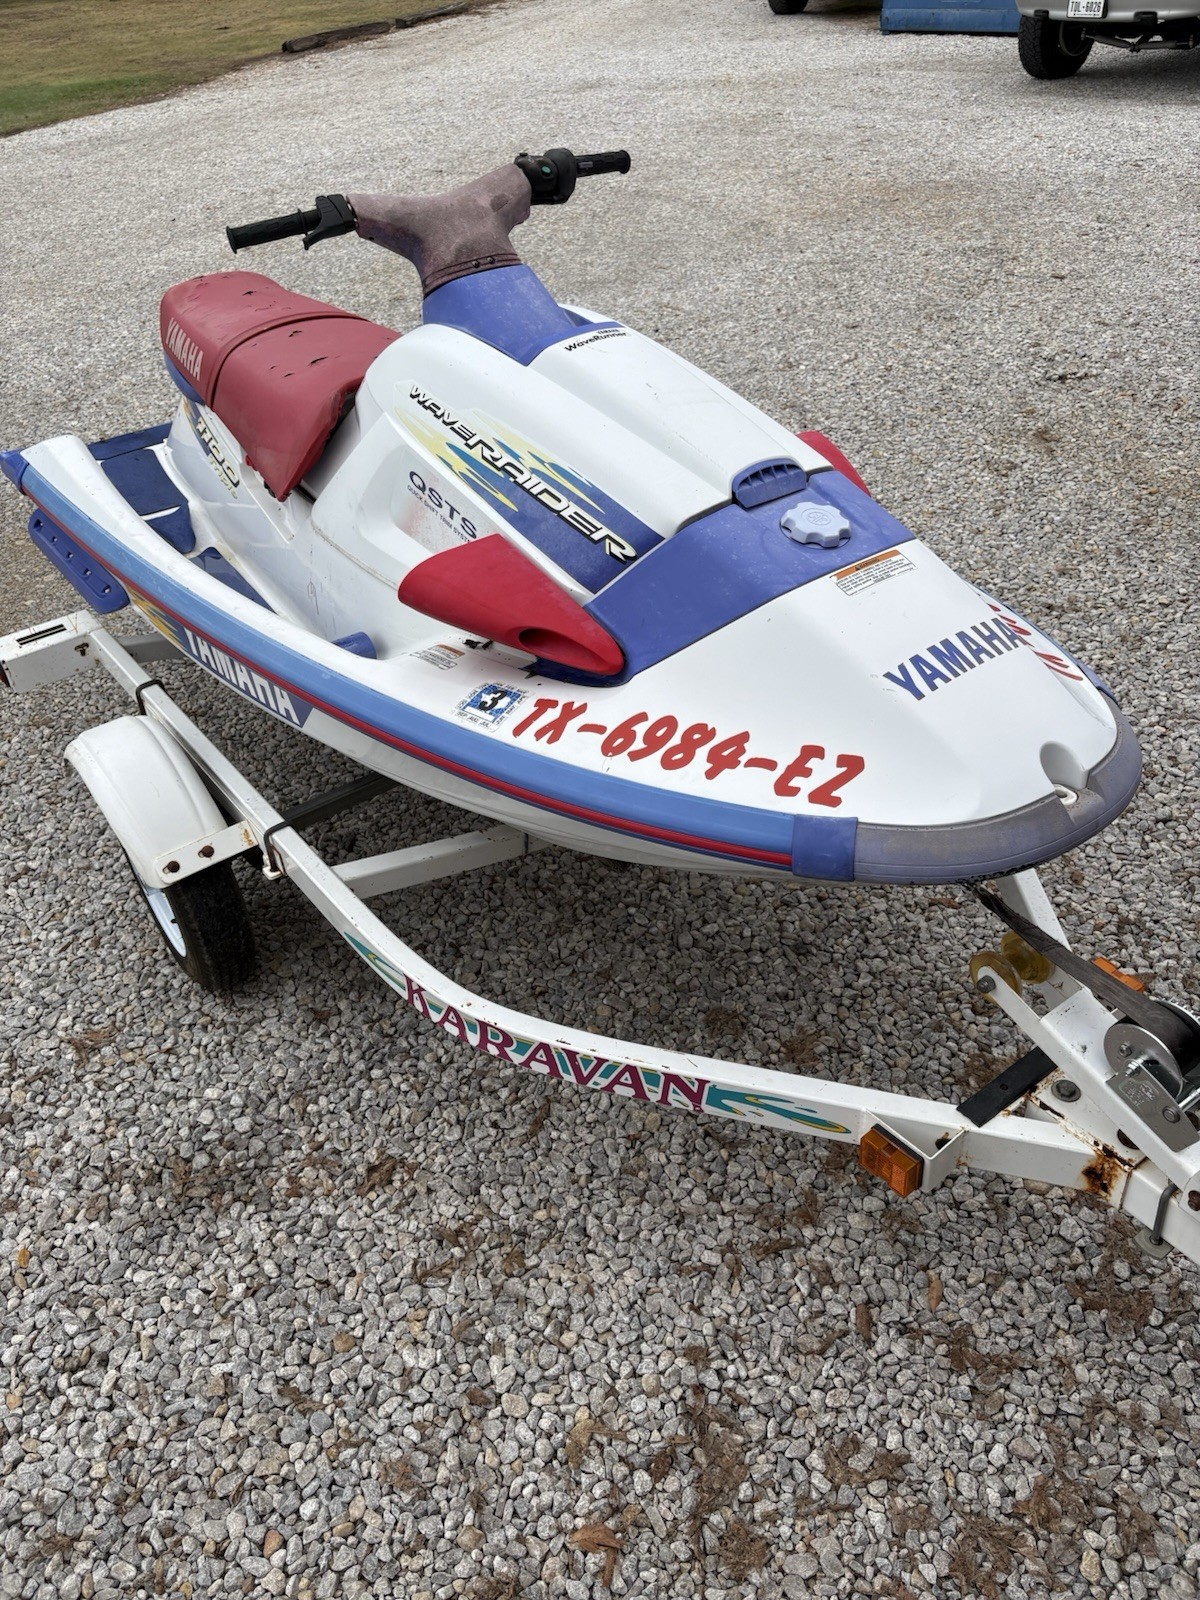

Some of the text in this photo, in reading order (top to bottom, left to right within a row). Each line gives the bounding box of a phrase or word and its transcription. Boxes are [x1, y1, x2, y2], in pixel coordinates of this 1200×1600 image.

[165, 317, 204, 381] YAMAHA
[564, 332, 627, 352] WaveRunner
[409, 384, 638, 565] WAVERAIDER
[409, 471, 477, 539] QSTS
[882, 617, 1028, 701] YAMAHA
[479, 690, 508, 711] 3
[512, 698, 865, 808] TX-6984-EZ
[402, 972, 711, 1114] KARAVAN
